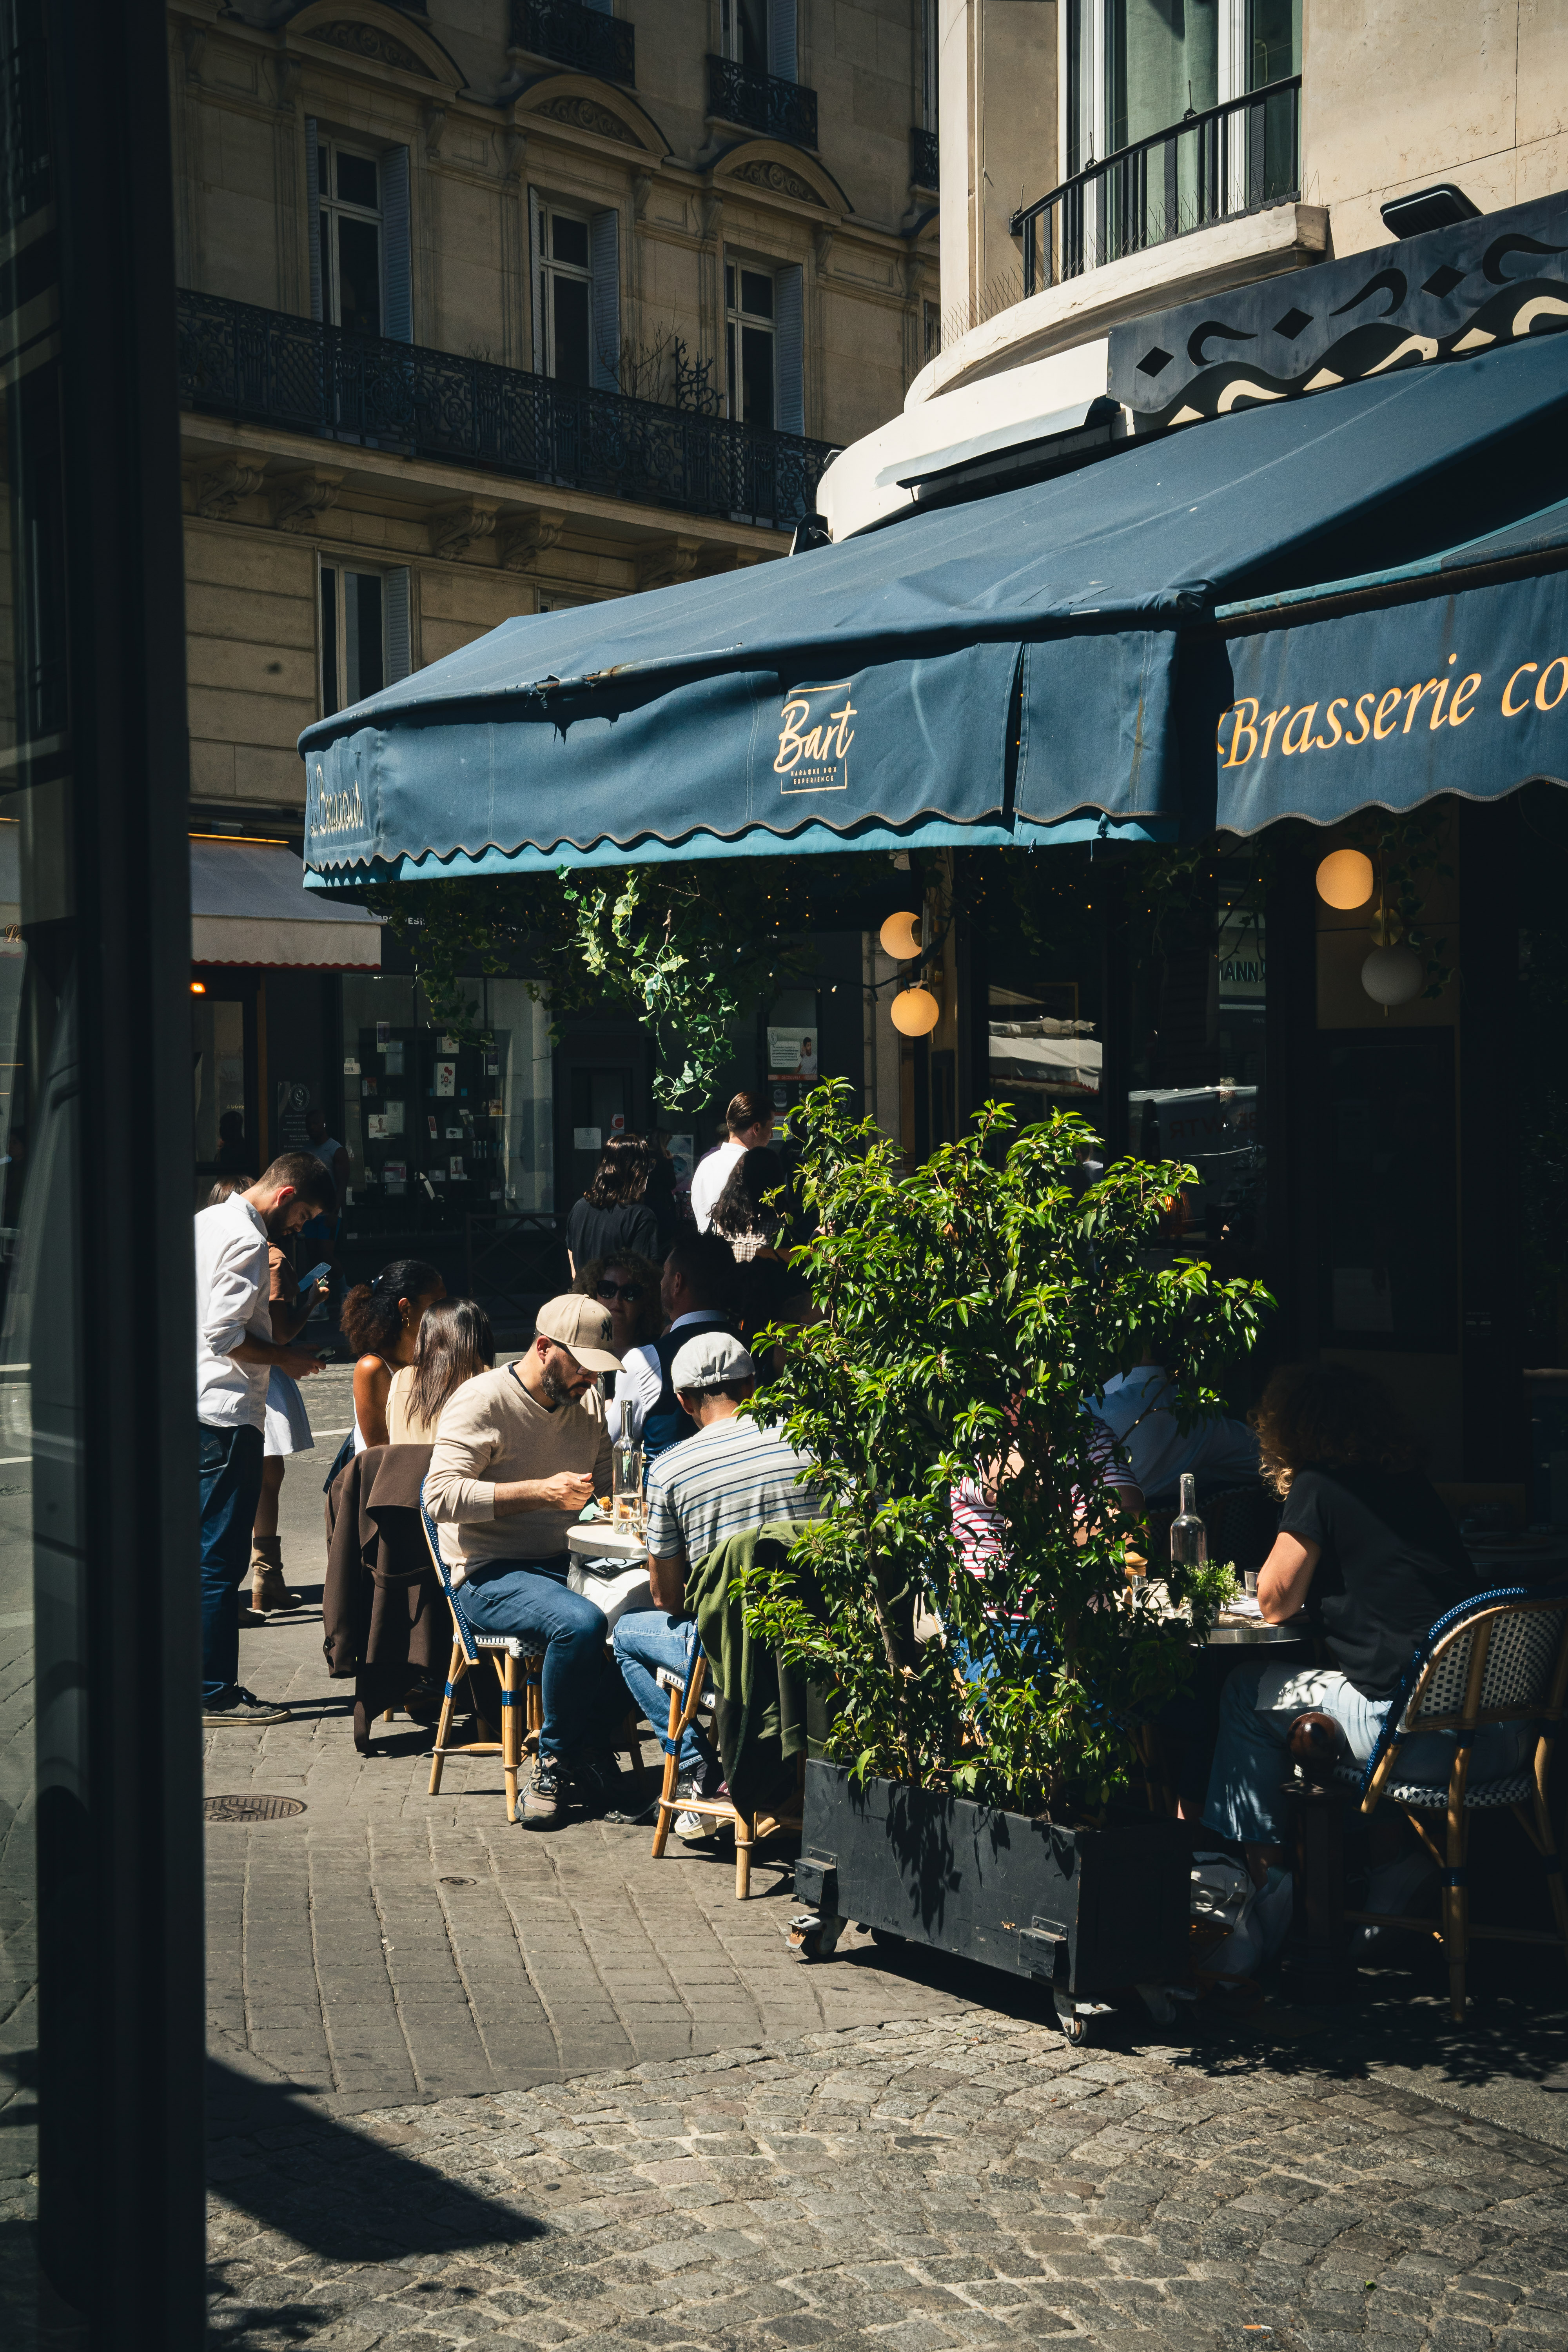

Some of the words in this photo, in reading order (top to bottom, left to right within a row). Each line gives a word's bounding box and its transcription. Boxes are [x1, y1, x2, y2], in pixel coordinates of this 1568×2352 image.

[1216, 653, 1482, 768] Brasserie
[773, 700, 857, 773] Bart
[791, 768, 820, 777] KARAOKE
[793, 775, 834, 785] EXPERIENCE
[3, 924, 22, 943] Le
